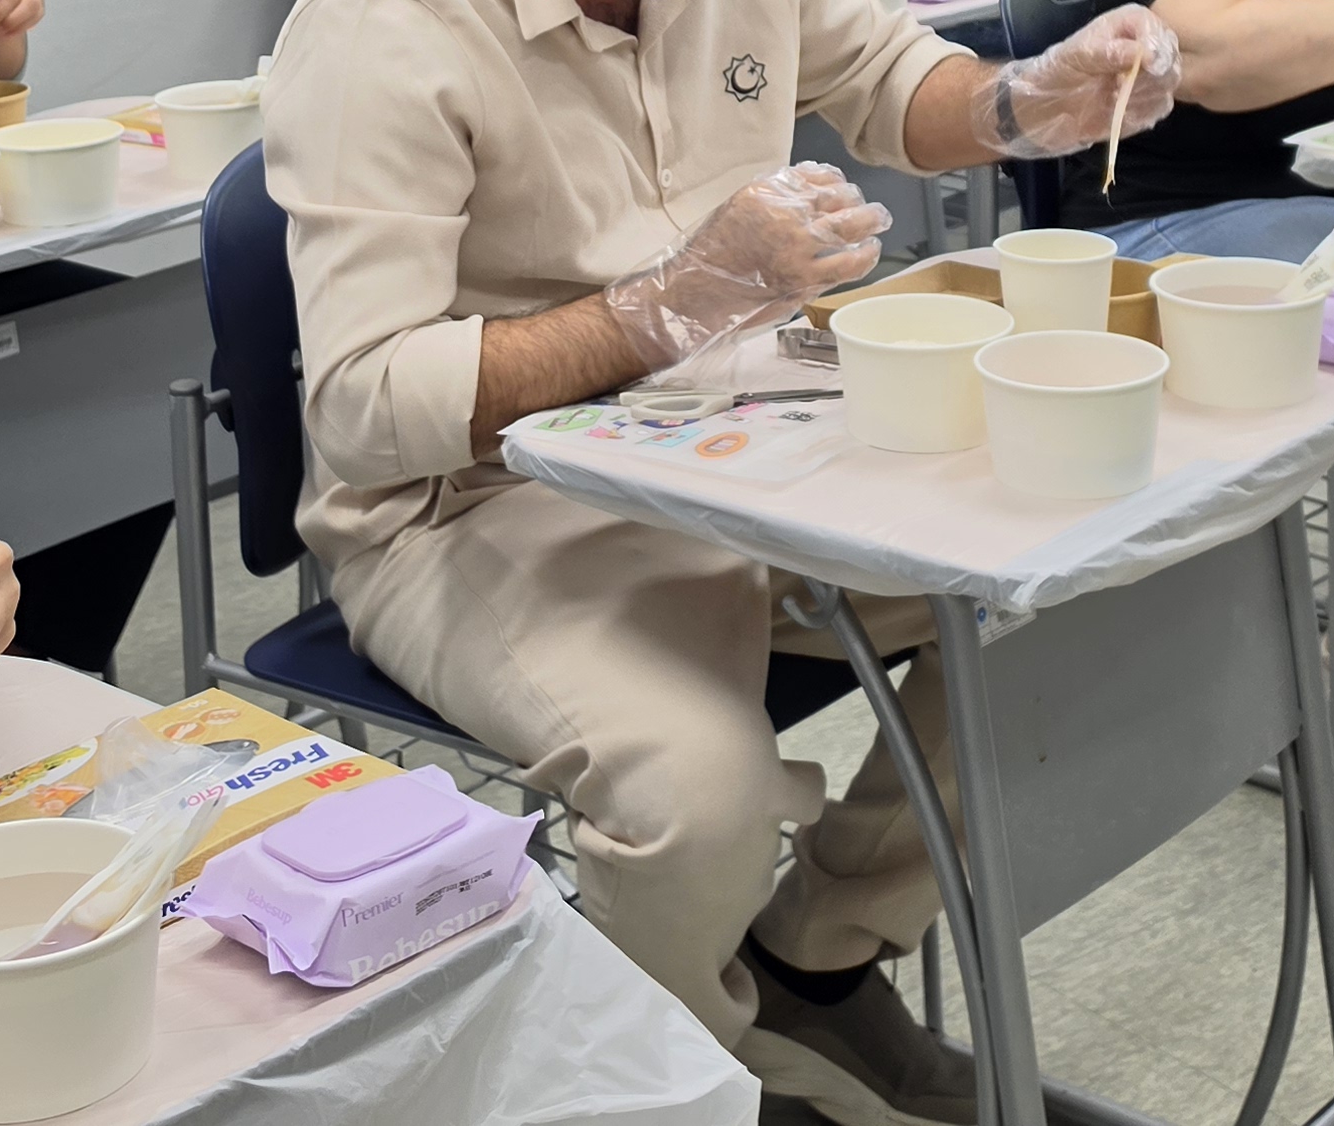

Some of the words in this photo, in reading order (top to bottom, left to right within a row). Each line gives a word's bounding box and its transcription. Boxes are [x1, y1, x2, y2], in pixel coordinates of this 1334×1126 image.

[224, 743, 330, 791] Fresh
[305, 762, 364, 790] 3M
[341, 891, 405, 928] Premier
